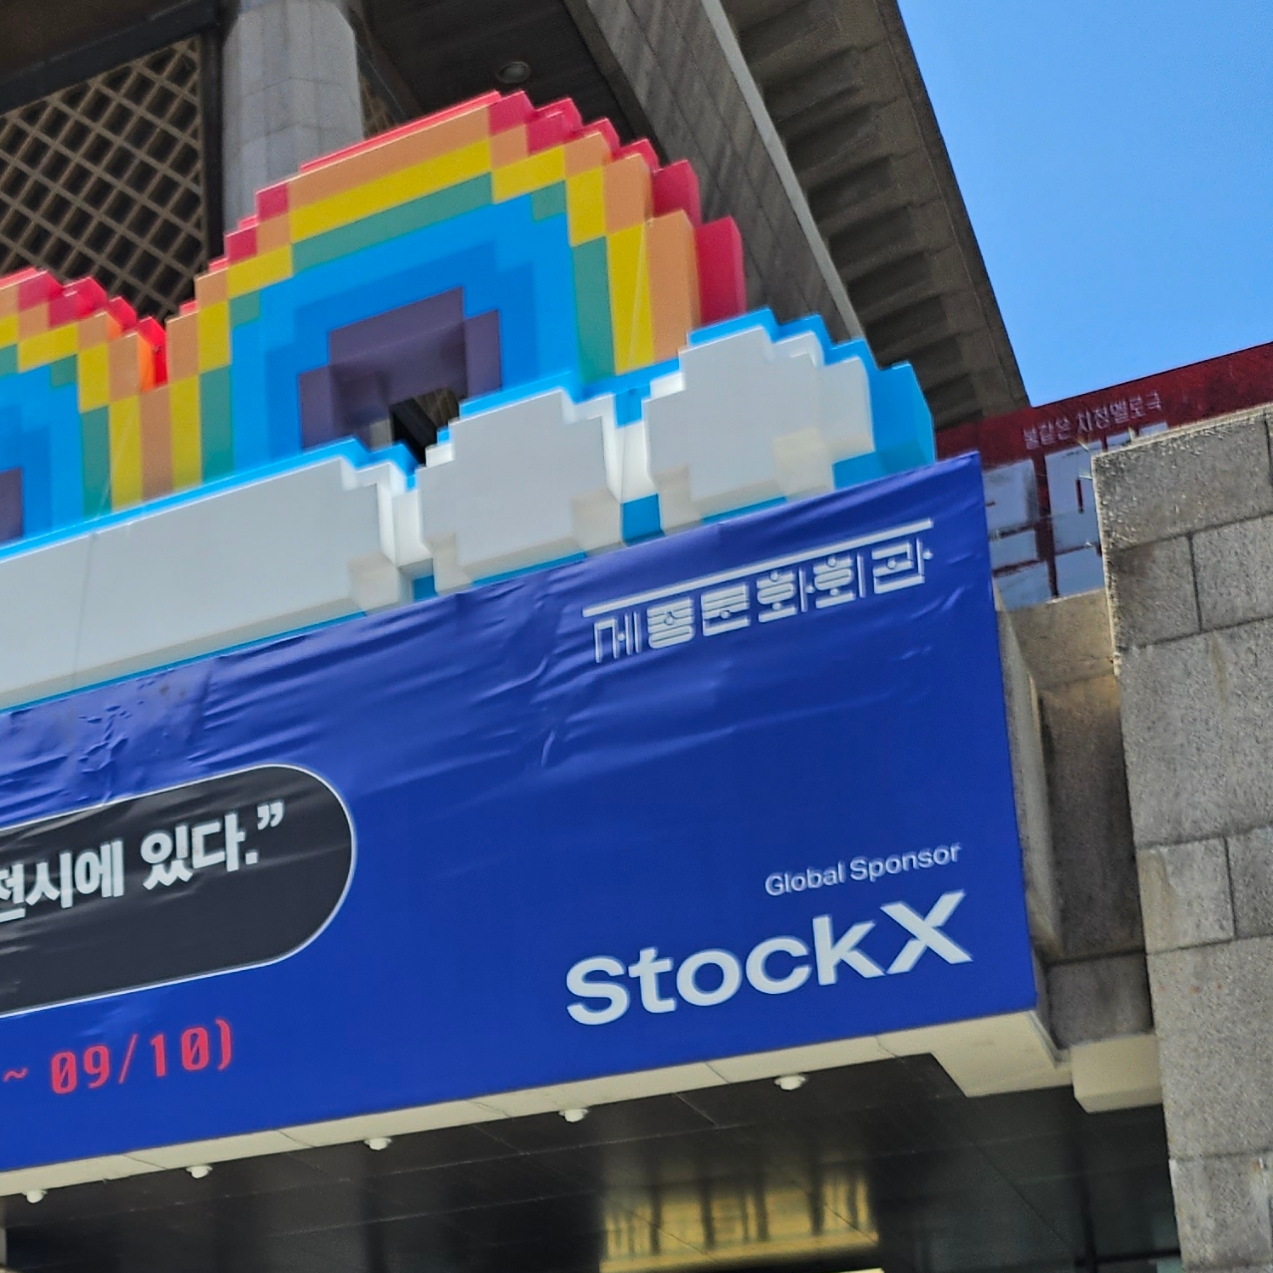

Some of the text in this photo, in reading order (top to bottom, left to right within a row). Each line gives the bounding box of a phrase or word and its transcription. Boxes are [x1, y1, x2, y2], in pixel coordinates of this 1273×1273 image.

[764, 842, 962, 896] Global Sponsor
[565, 888, 974, 1026] StockX
[50, 1017, 233, 1095] 09/10)
